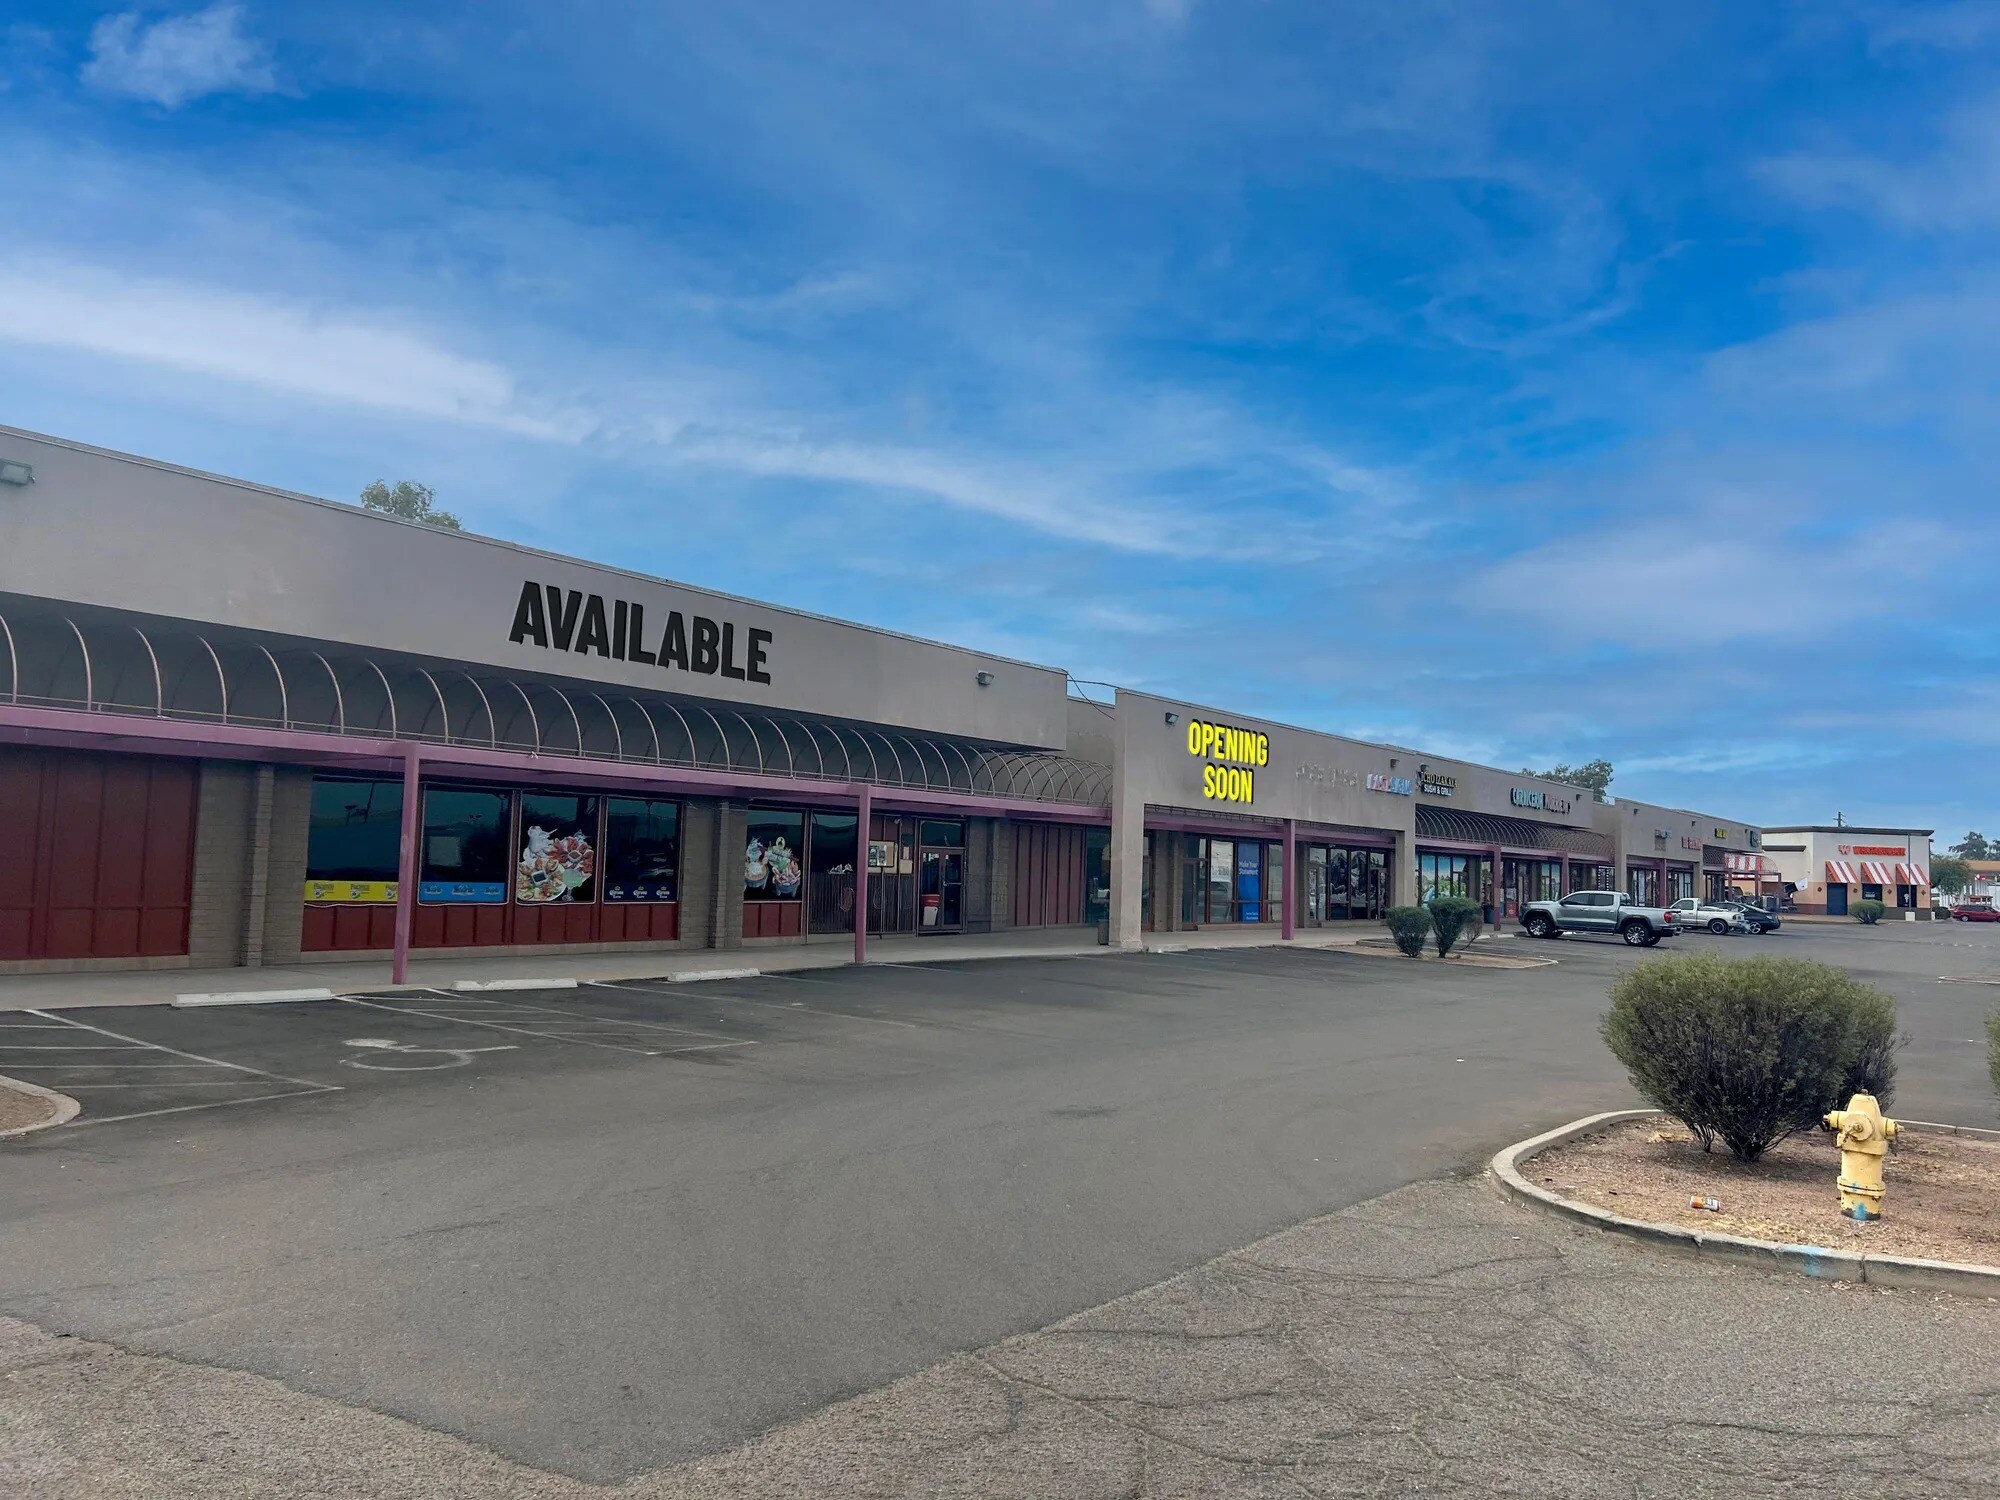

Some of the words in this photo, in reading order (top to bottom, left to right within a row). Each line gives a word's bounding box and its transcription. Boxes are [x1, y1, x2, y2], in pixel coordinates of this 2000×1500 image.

[508, 580, 773, 686] AVAILABLE
[1188, 719, 1270, 768] OPENING
[1204, 762, 1254, 804] SOON
[1424, 783, 1437, 793] SUSHI
